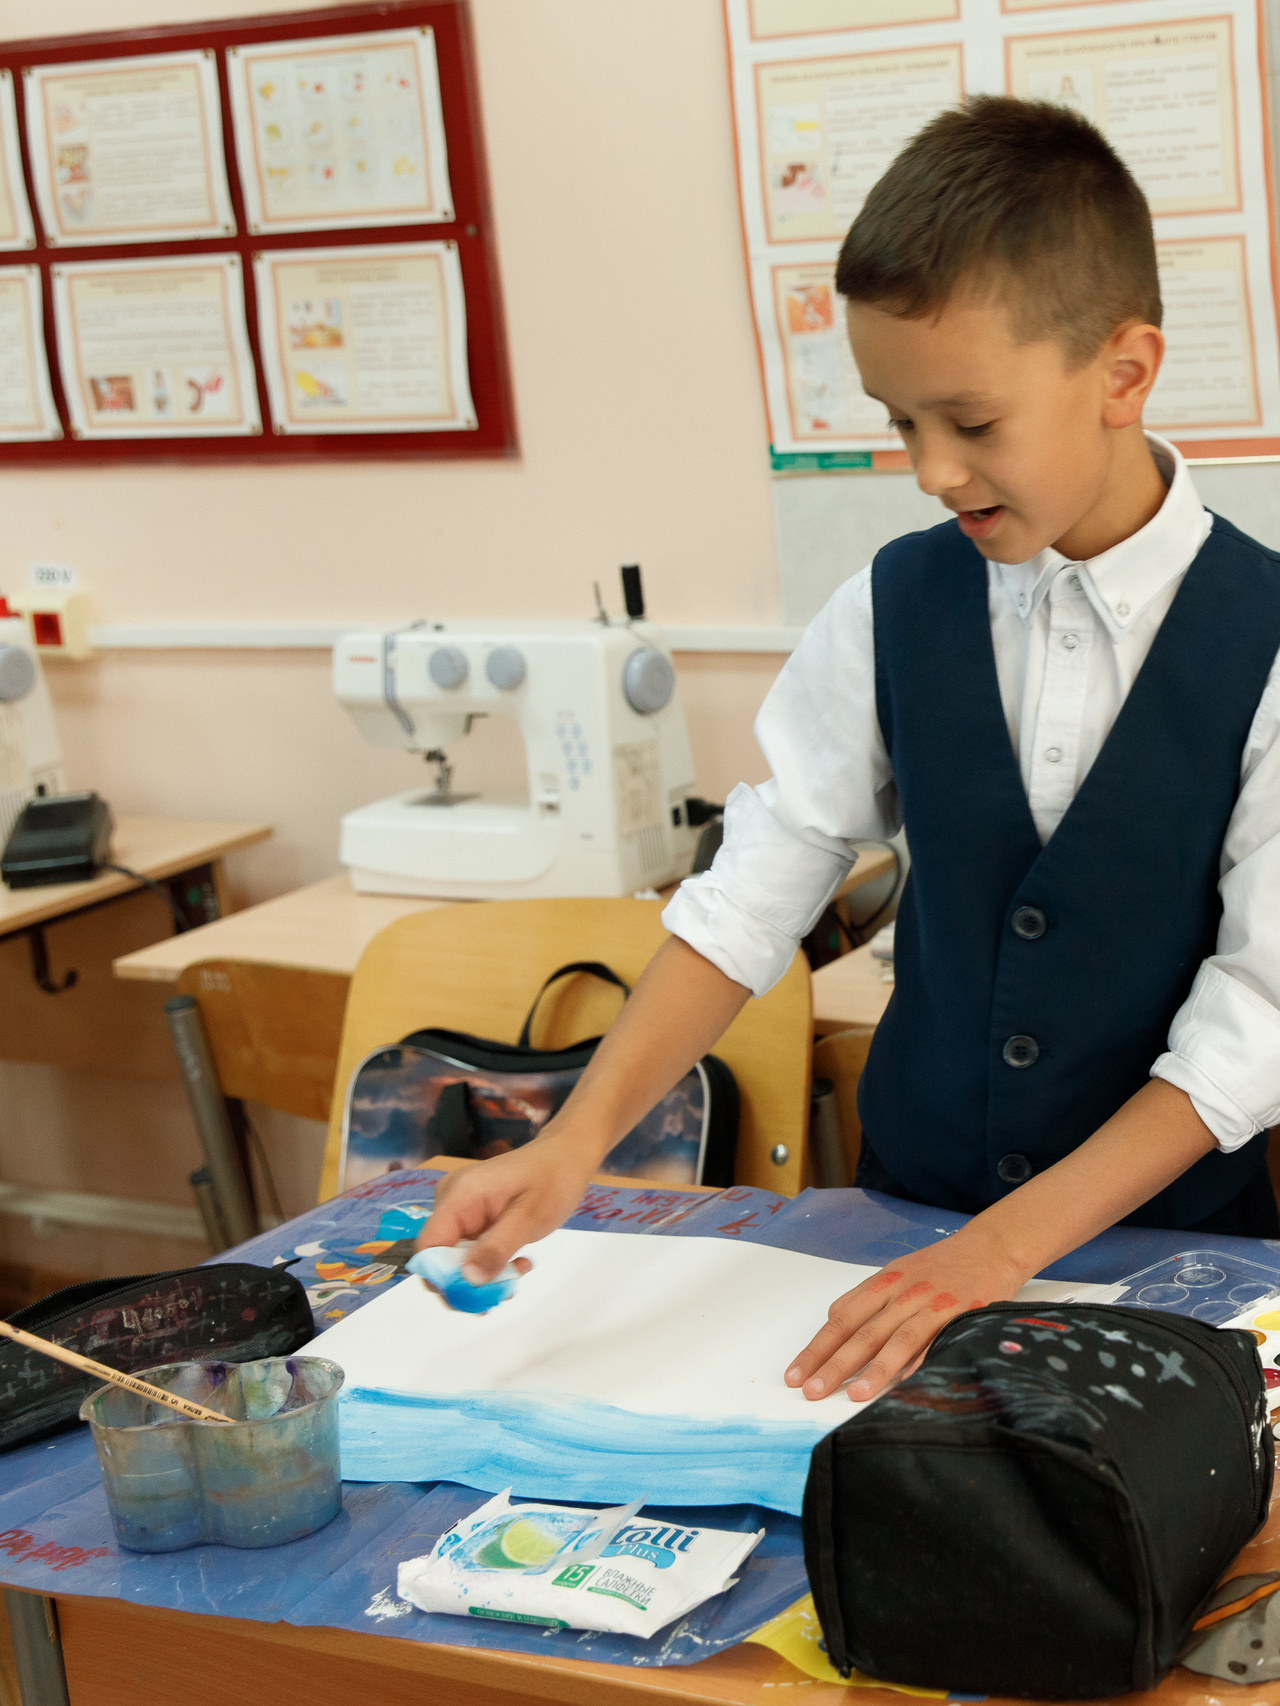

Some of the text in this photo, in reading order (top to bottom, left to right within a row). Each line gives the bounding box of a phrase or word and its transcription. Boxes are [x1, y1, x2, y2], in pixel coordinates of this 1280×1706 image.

[564, 1565, 588, 1581] 15
[602, 1568, 658, 1597] ВЛАЖНЫЕ
[595, 1576, 653, 1606] САЛФЕТКИ
